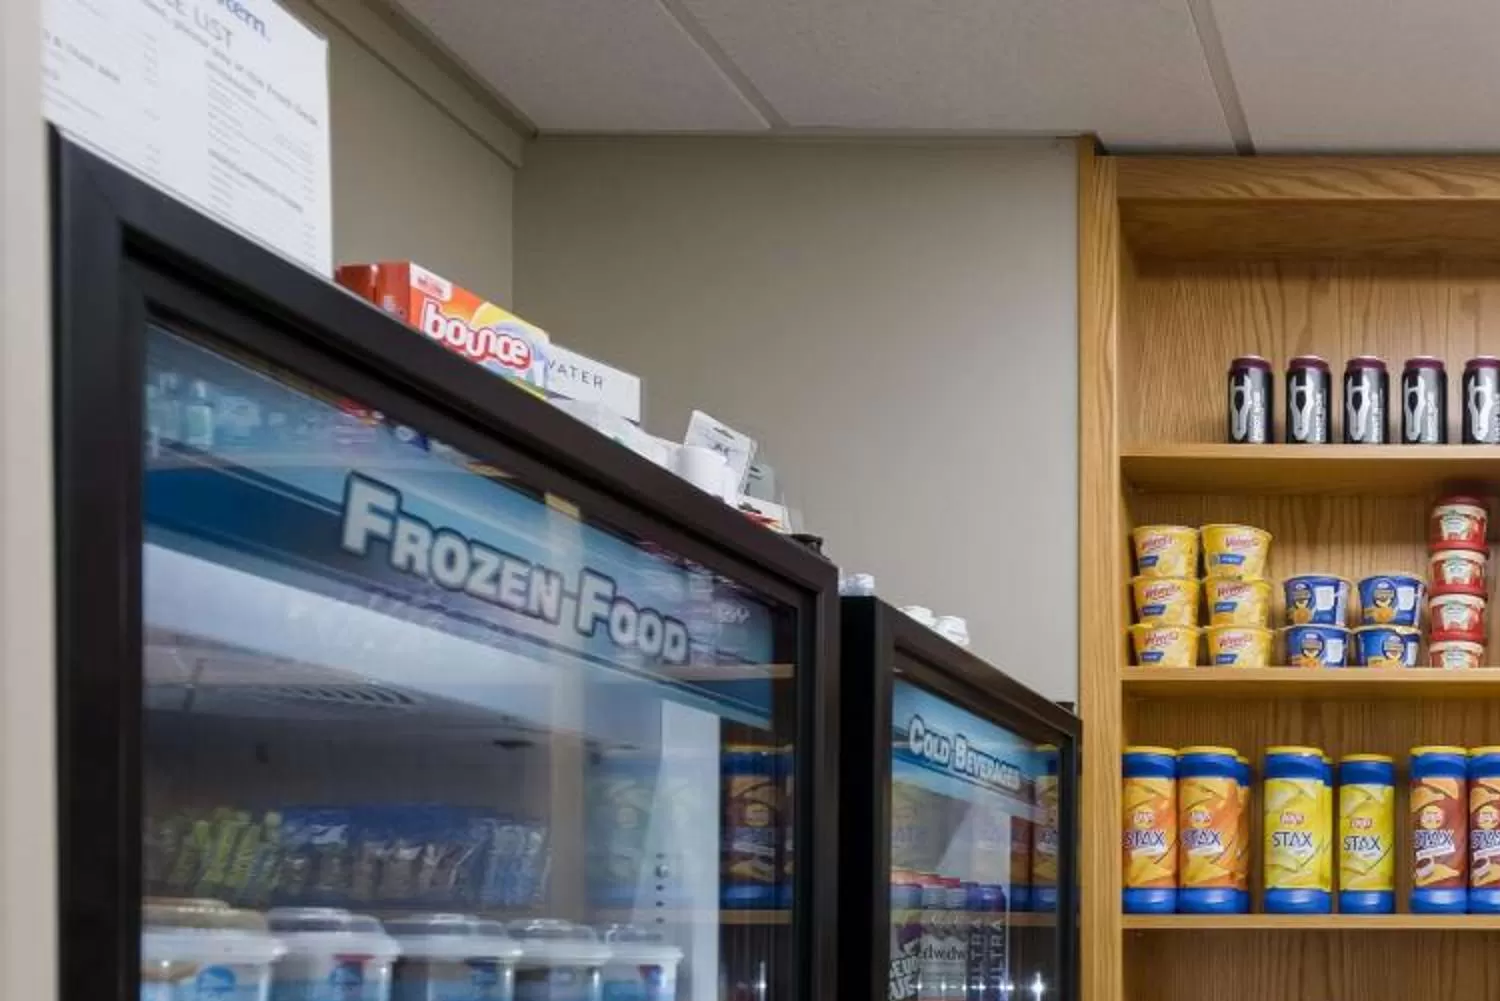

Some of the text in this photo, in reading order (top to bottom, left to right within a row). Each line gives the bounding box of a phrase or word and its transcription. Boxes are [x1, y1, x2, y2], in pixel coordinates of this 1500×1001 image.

[193, 4, 233, 49] LIST
[423, 299, 531, 369] bounce
[1272, 831, 1313, 848] STAX
[1344, 835, 1382, 851] STAX
